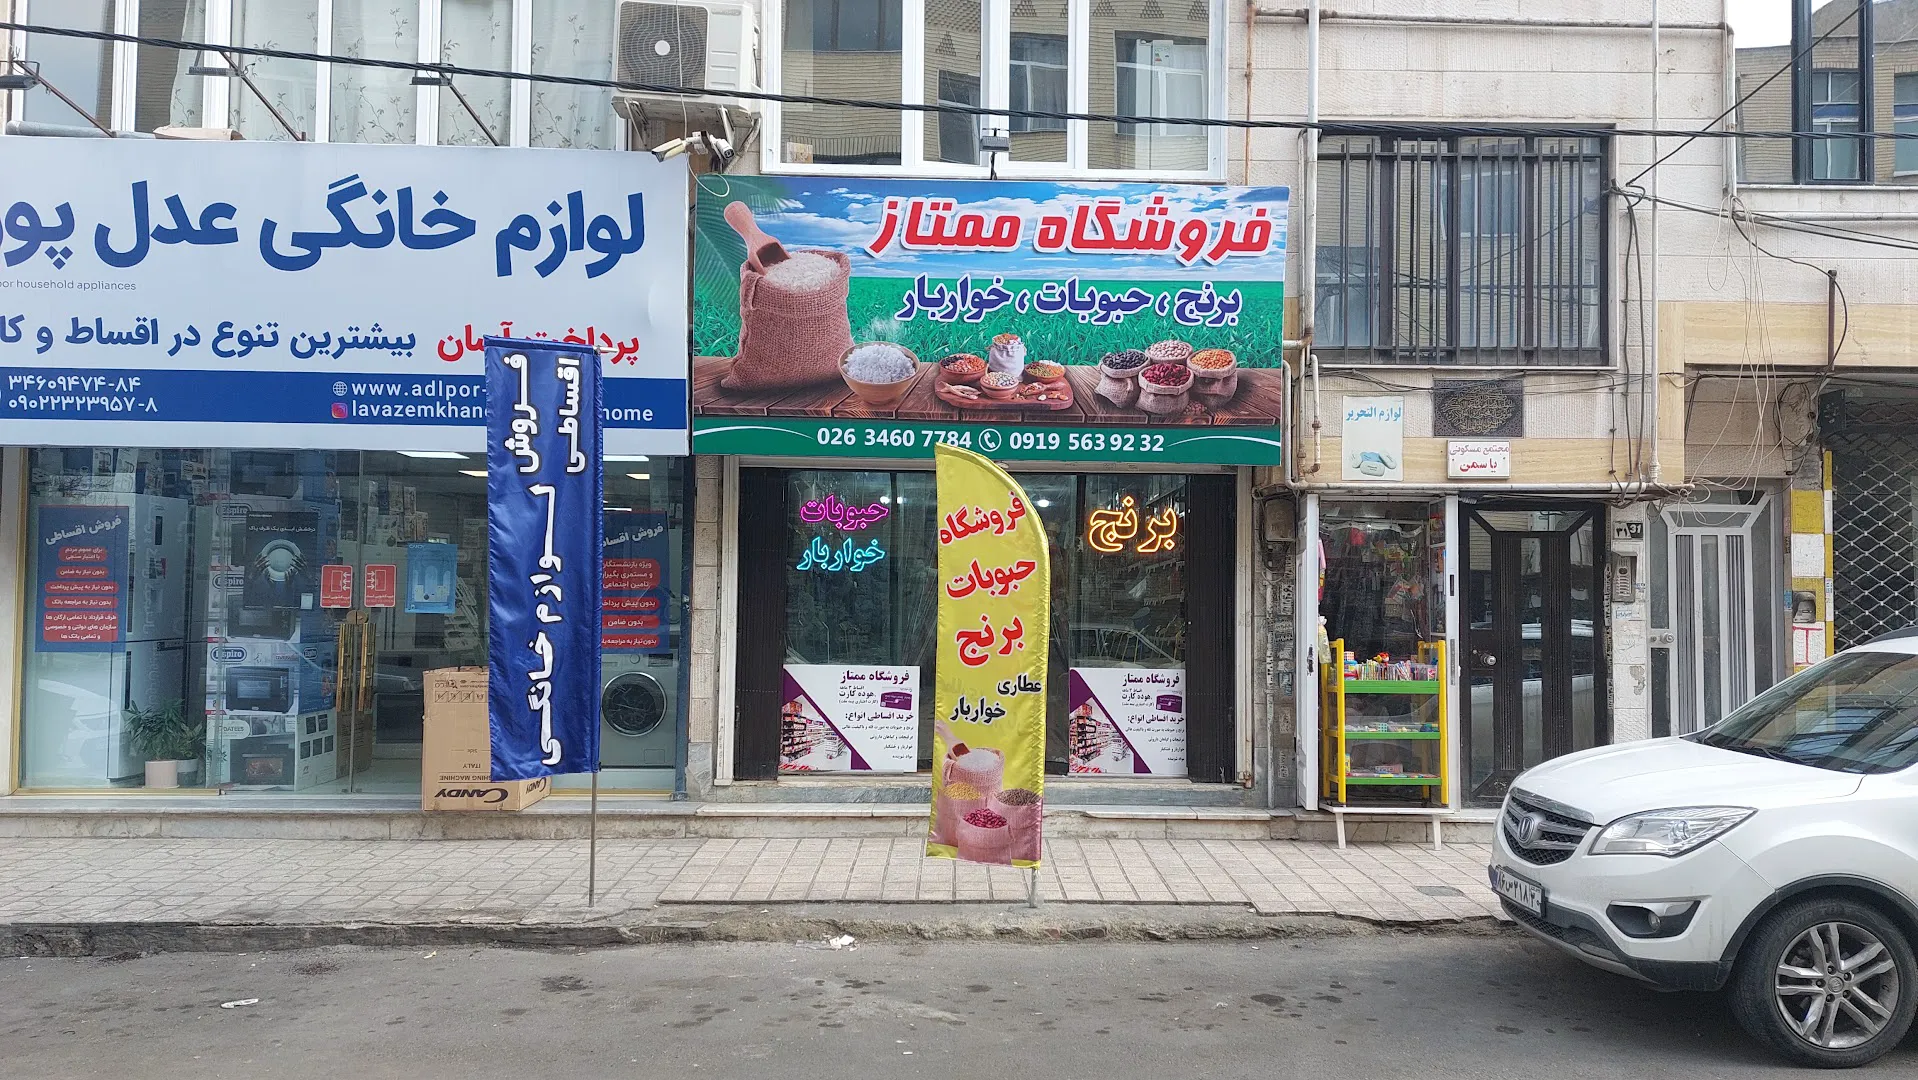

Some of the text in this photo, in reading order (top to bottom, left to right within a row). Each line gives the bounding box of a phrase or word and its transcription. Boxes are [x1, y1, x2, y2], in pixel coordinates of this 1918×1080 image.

[0, 173, 646, 279] لوازم خانگی عدل پو
[868, 195, 1272, 263] فروشگاه ممتاز
[16, 279, 75, 290] household
[76, 280, 137, 292] appliances
[899, 275, 1011, 322] خواربار
[35, 325, 55, 355] و
[64, 315, 160, 346] اقساط
[167, 323, 202, 358] در
[211, 320, 280, 359] تنوع
[289, 322, 417, 360] بیشترین
[8, 375, 142, 393] ۳۴۶۰۹۴۷۴-۸۴
[504, 353, 540, 473] فروش
[557, 357, 586, 473] اقساطی
[1345, 406, 1402, 422] لوازم التحریر
[816, 427, 1165, 452] 026 3460 7784 0919 563 92 32
[1449, 444, 1510, 456] مجتمع مسکونی
[800, 494, 890, 531] حبوبات
[938, 491, 1027, 546] فروشگاه
[1087, 495, 1178, 554] برنج
[45, 515, 122, 545] فروش اقساطی
[632, 522, 664, 542] فروش
[1615, 527, 1628, 537] ۳۱
[1629, 524, 1642, 534] 31
[797, 536, 886, 573] خواربار
[945, 558, 1037, 600] حبوبات
[528, 483, 563, 766] لوازم خانگی
[955, 613, 1025, 667] برنج
[840, 669, 910, 685] فروشگاه ممتاز
[996, 675, 1043, 698] عطاری
[1122, 672, 1180, 688] فروشگاه ممتاز
[867, 711, 895, 722] اقساطی
[896, 712, 914, 722] خرید
[949, 696, 1007, 722] خواربار
[1145, 714, 1169, 724] اقساطی
[1169, 714, 1185, 725] خرید
[434, 787, 509, 804] CANDY
